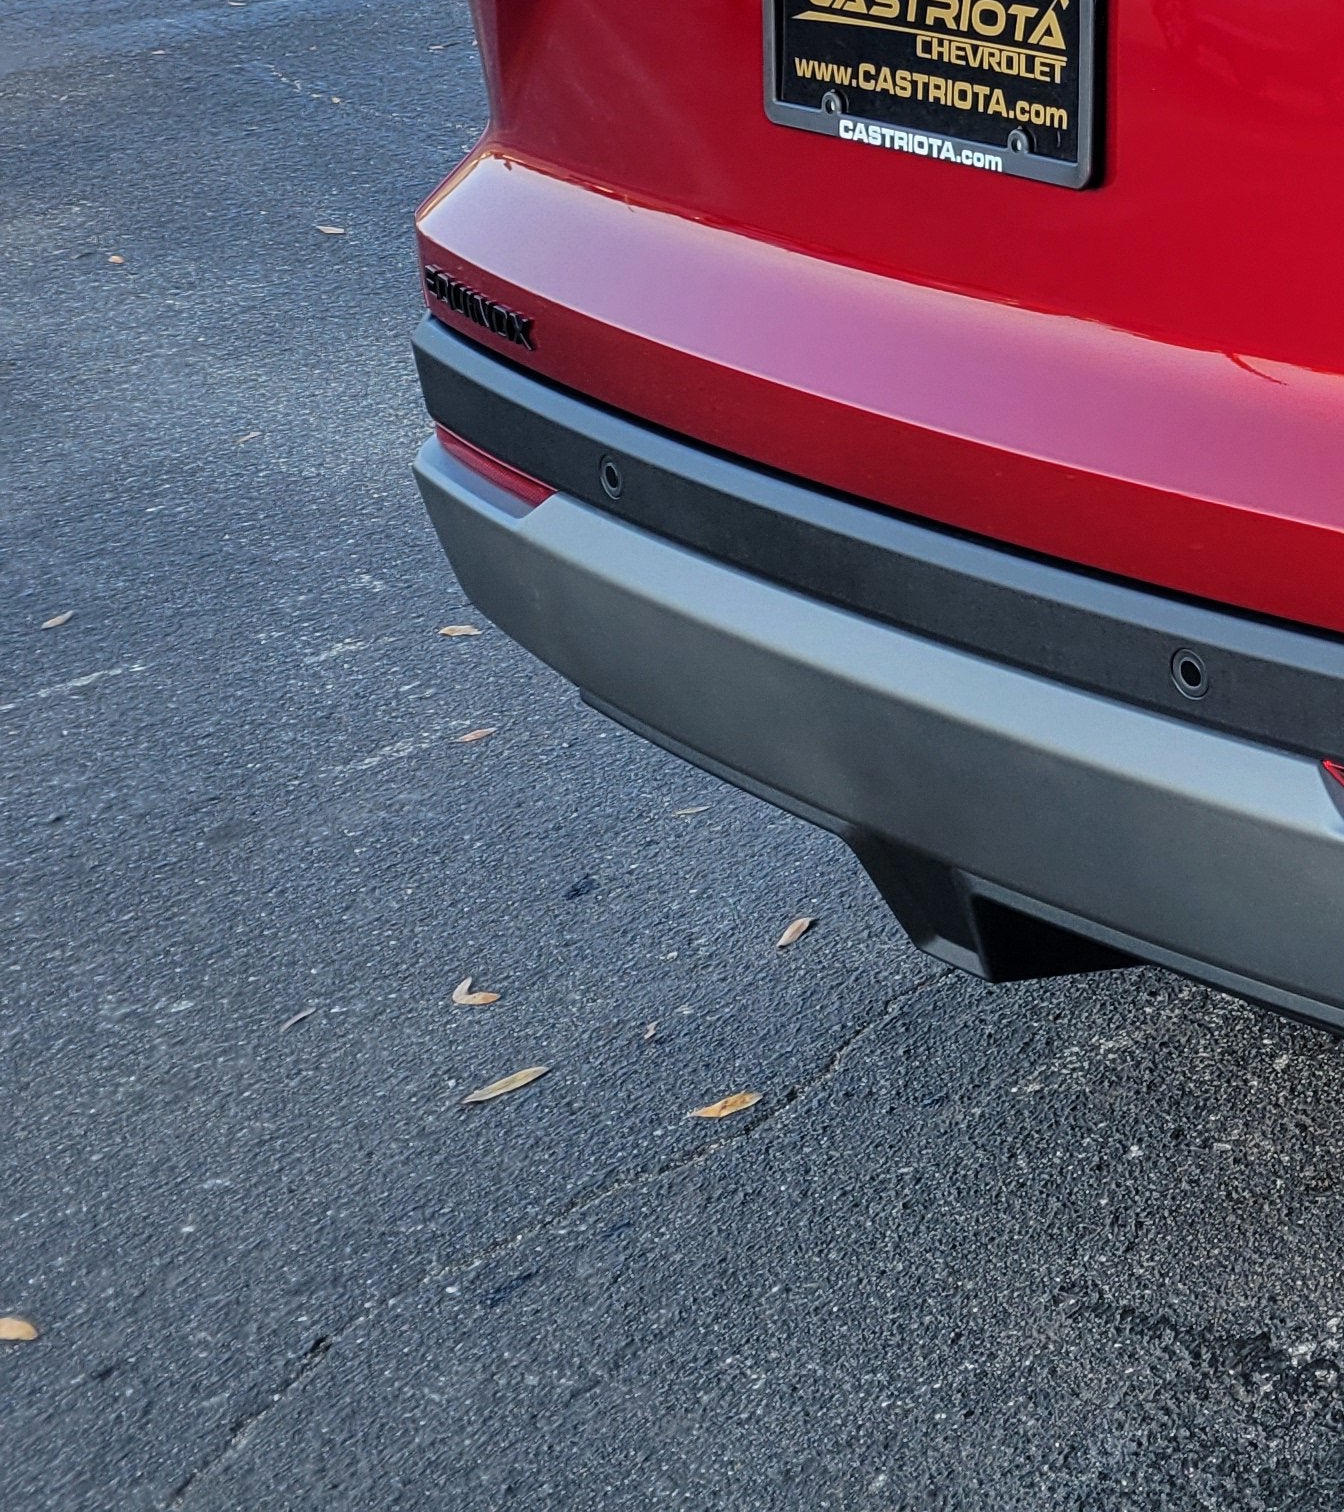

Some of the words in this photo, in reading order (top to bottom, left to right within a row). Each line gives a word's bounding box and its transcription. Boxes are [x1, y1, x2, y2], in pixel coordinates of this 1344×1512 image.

[916, 35, 1068, 84] CHEVROLET
[794, 57, 1069, 130] www.CASTRIOTA.com
[838, 119, 1003, 172] CASTRIOTA.com
